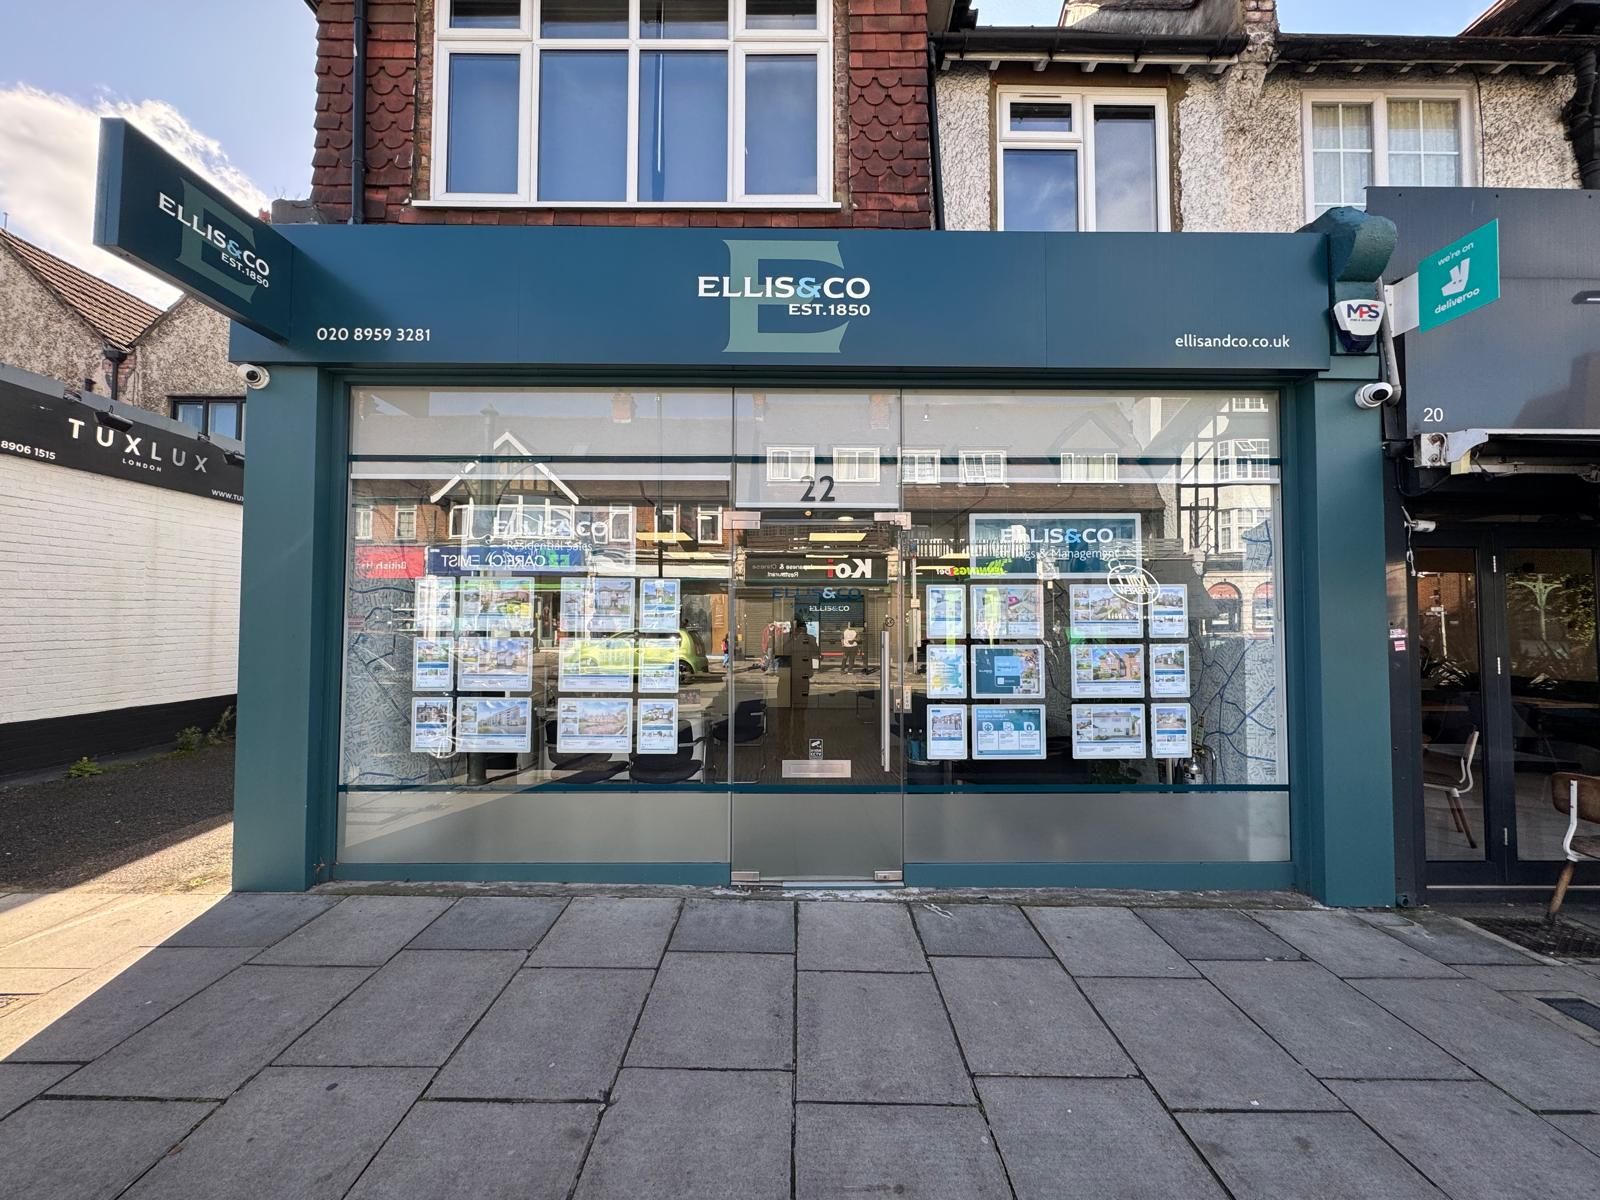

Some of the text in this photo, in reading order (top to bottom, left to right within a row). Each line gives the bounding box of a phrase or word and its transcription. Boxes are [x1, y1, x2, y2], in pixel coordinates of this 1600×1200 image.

[157, 191, 270, 278] ELLIS&CO
[1437, 242, 1475, 267] we're on
[220, 251, 270, 289] EST.1850
[697, 276, 871, 299] ELLIS&CO
[788, 303, 871, 317] EST.1850
[1434, 287, 1481, 315] deliveroo
[1346, 303, 1380, 319] MPS
[316, 327, 431, 342] 020 8959 3281
[1174, 332, 1291, 349] ellisandco.co.uk
[1422, 407, 1444, 423] 20
[0, 440, 56, 461] 8906 1515
[122, 457, 163, 473] LONDON
[799, 475, 836, 502] 22
[506, 540, 564, 551] Residential
